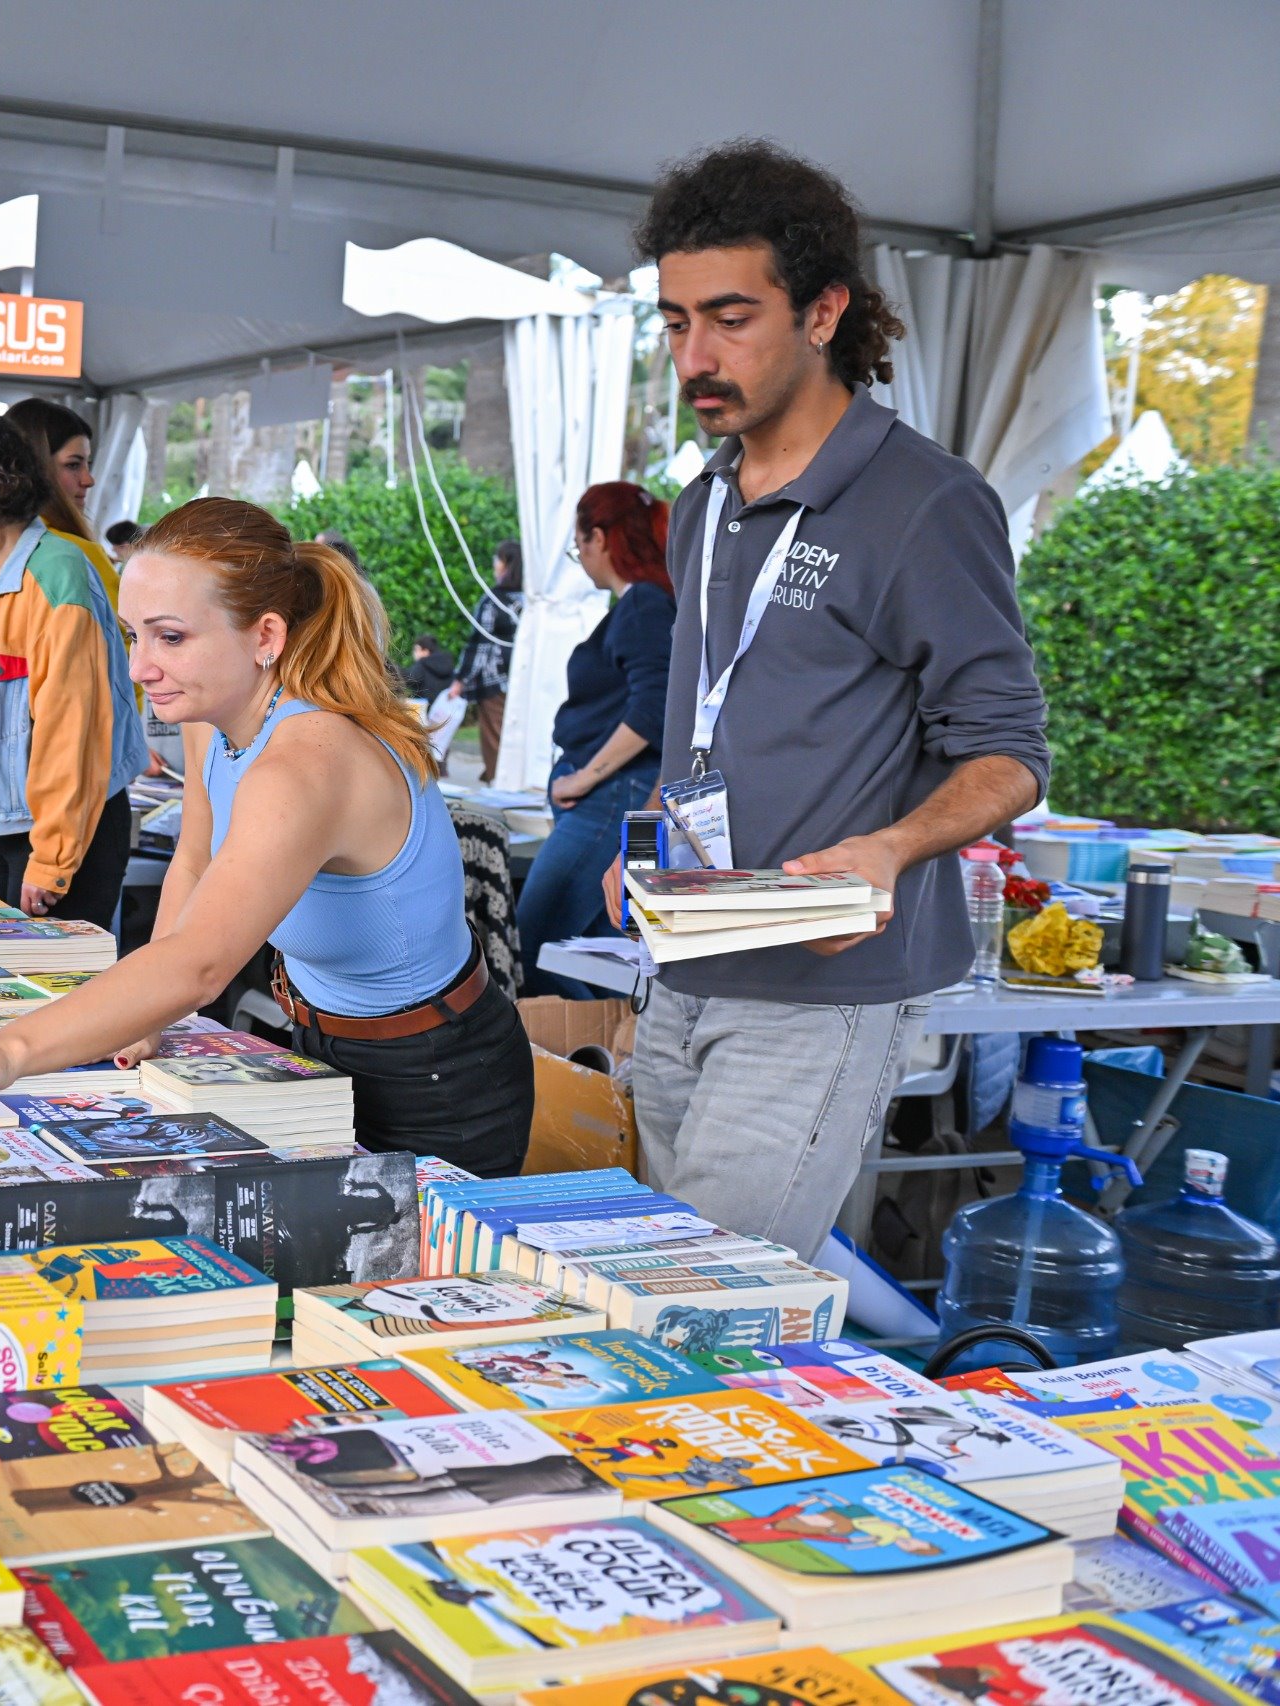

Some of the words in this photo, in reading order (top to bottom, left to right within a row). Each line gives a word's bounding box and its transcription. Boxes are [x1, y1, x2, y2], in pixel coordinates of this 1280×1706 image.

[780, 561, 829, 589] AYIN
[784, 541, 840, 572] UDEM
[592, 1256, 668, 1273] KARANLIK
[621, 1268, 693, 1281] ANAHTAR
[648, 1279, 720, 1294] ANAHTAR
[37, 1351, 48, 1385] Sally
[854, 1366, 923, 1398] PİYON
[1074, 1364, 1132, 1383] Boyama
[635, 1402, 792, 1472] ROBOT
[994, 1417, 1076, 1458] ADALET
[490, 1557, 576, 1613] KÖPEK
[521, 1551, 608, 1612] HARİKA
[562, 1539, 677, 1609] ÇOCUK
[606, 1537, 706, 1602] ULTRA
[119, 1593, 171, 1634] KAL
[284, 1655, 350, 1706] Zirv
